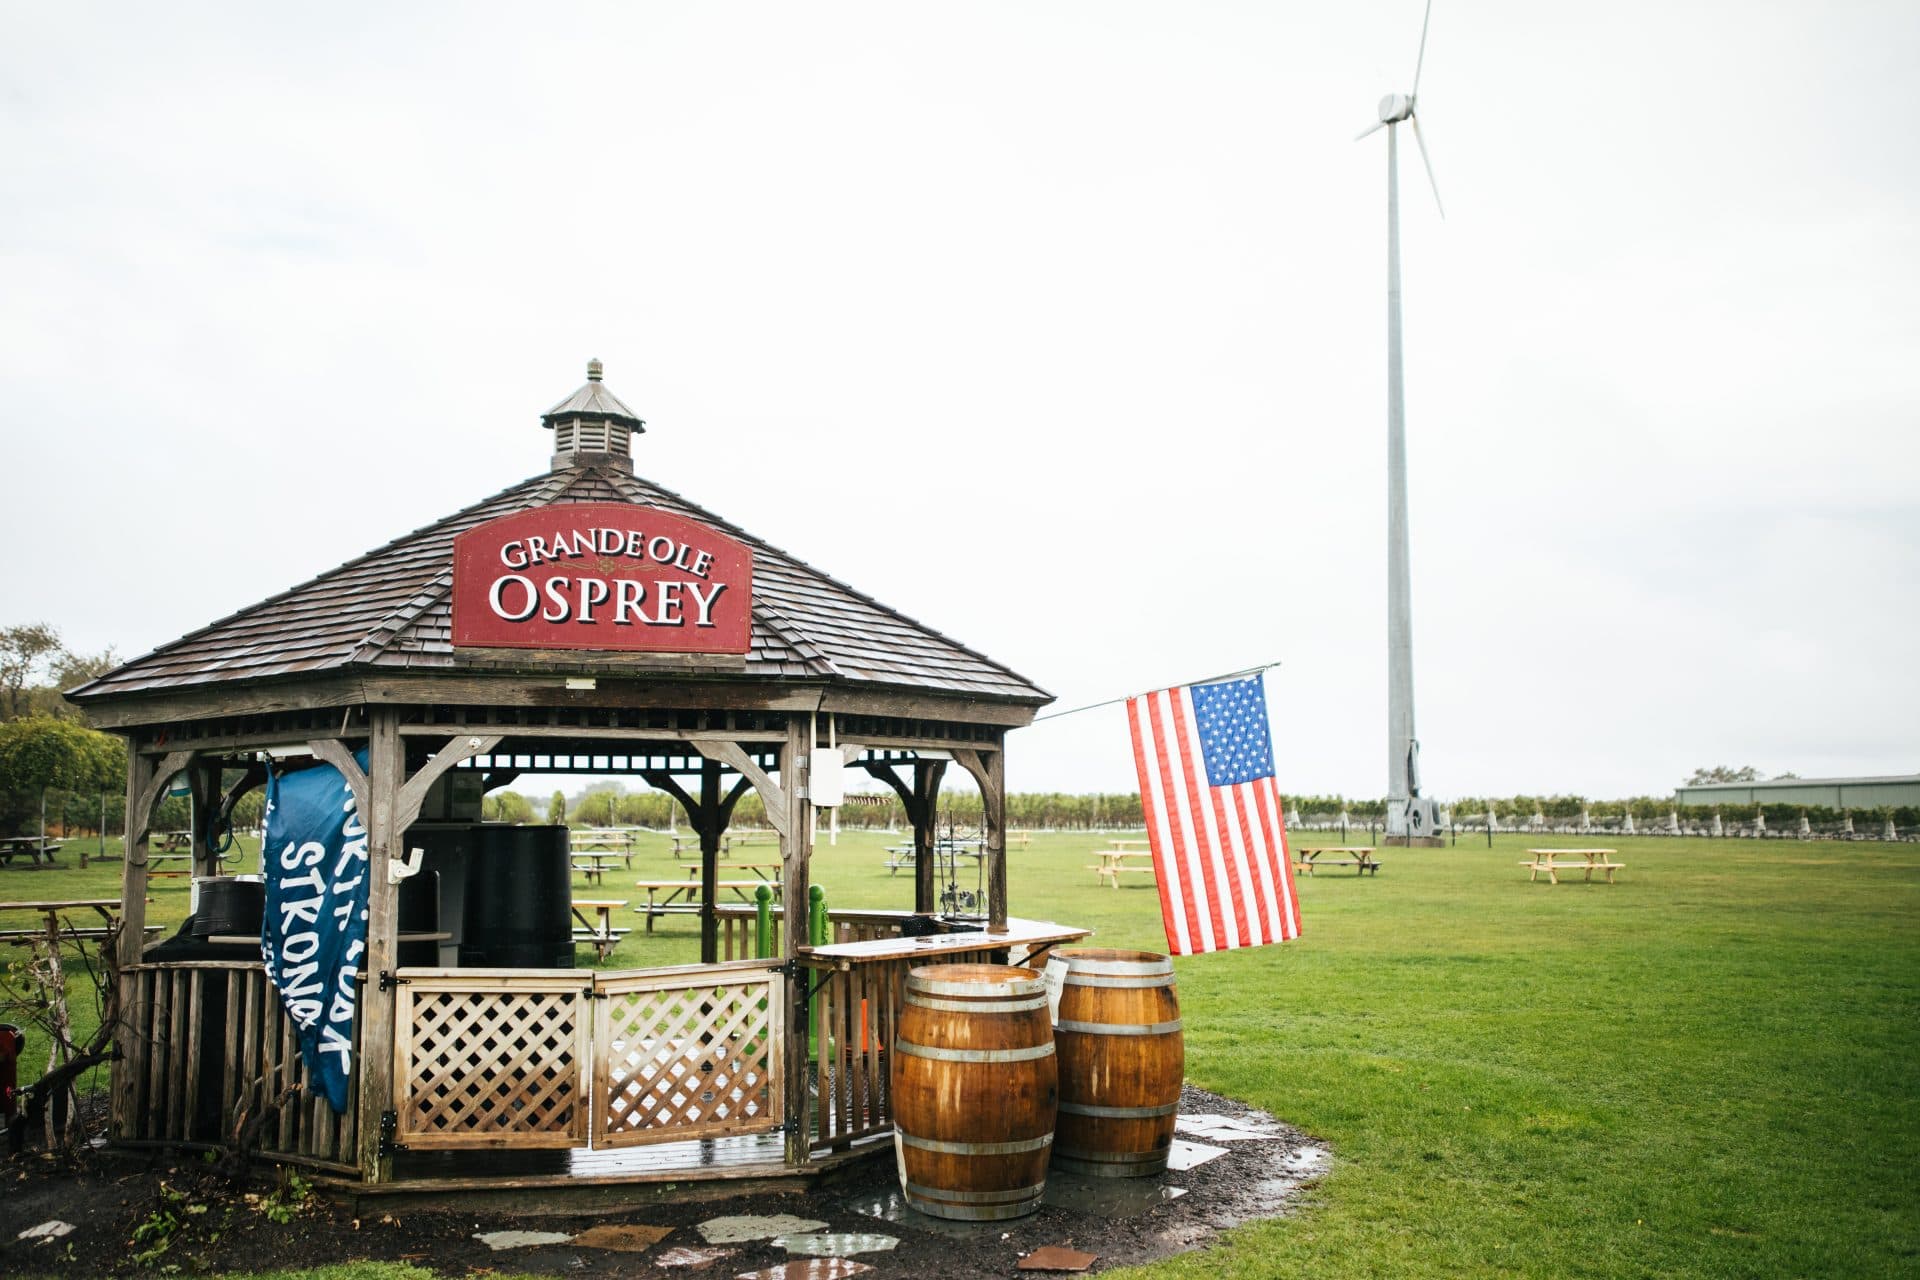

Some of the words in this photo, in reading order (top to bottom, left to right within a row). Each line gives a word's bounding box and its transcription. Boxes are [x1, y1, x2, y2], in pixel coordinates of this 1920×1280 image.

[500, 528, 643, 569] GRANDE
[648, 536, 714, 578] OLE
[489, 574, 727, 627] OSPREY
